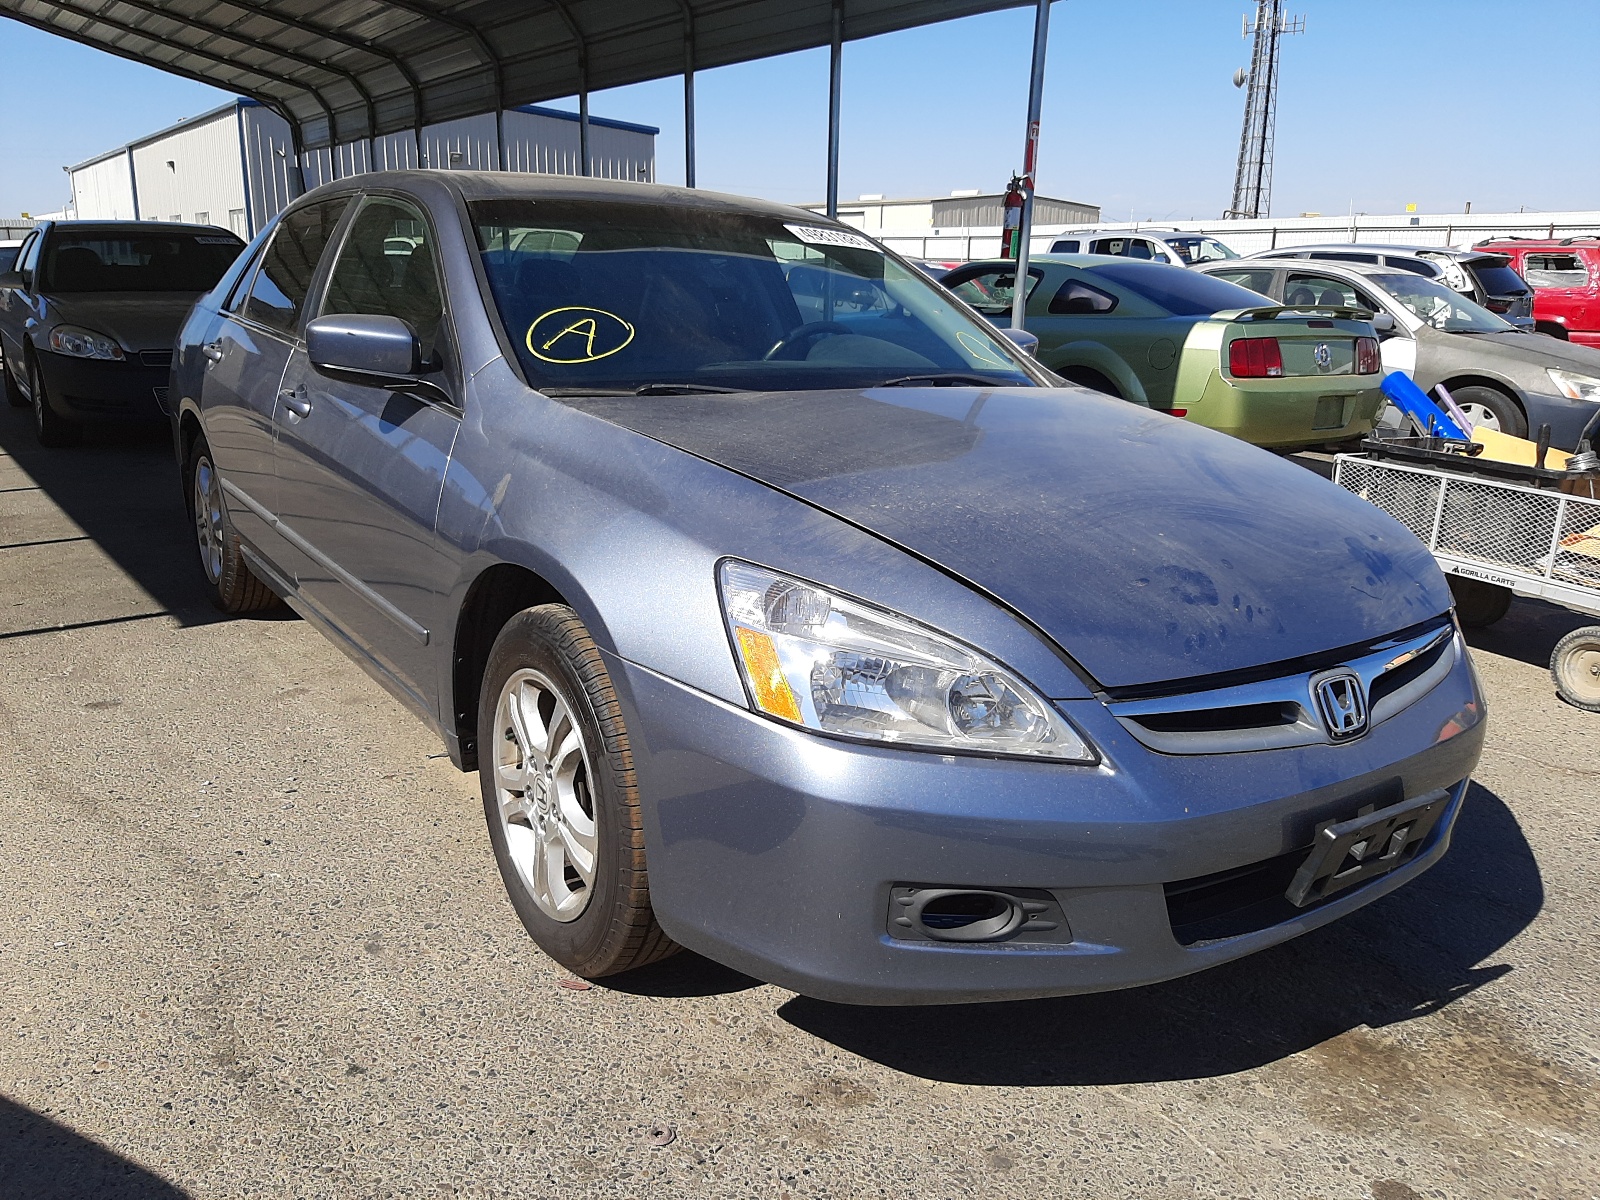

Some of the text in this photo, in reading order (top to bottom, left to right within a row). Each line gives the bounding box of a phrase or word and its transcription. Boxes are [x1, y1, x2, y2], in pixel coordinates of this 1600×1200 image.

[541, 318, 597, 358] A
[1460, 568, 1517, 587] GORILLA CARTS
